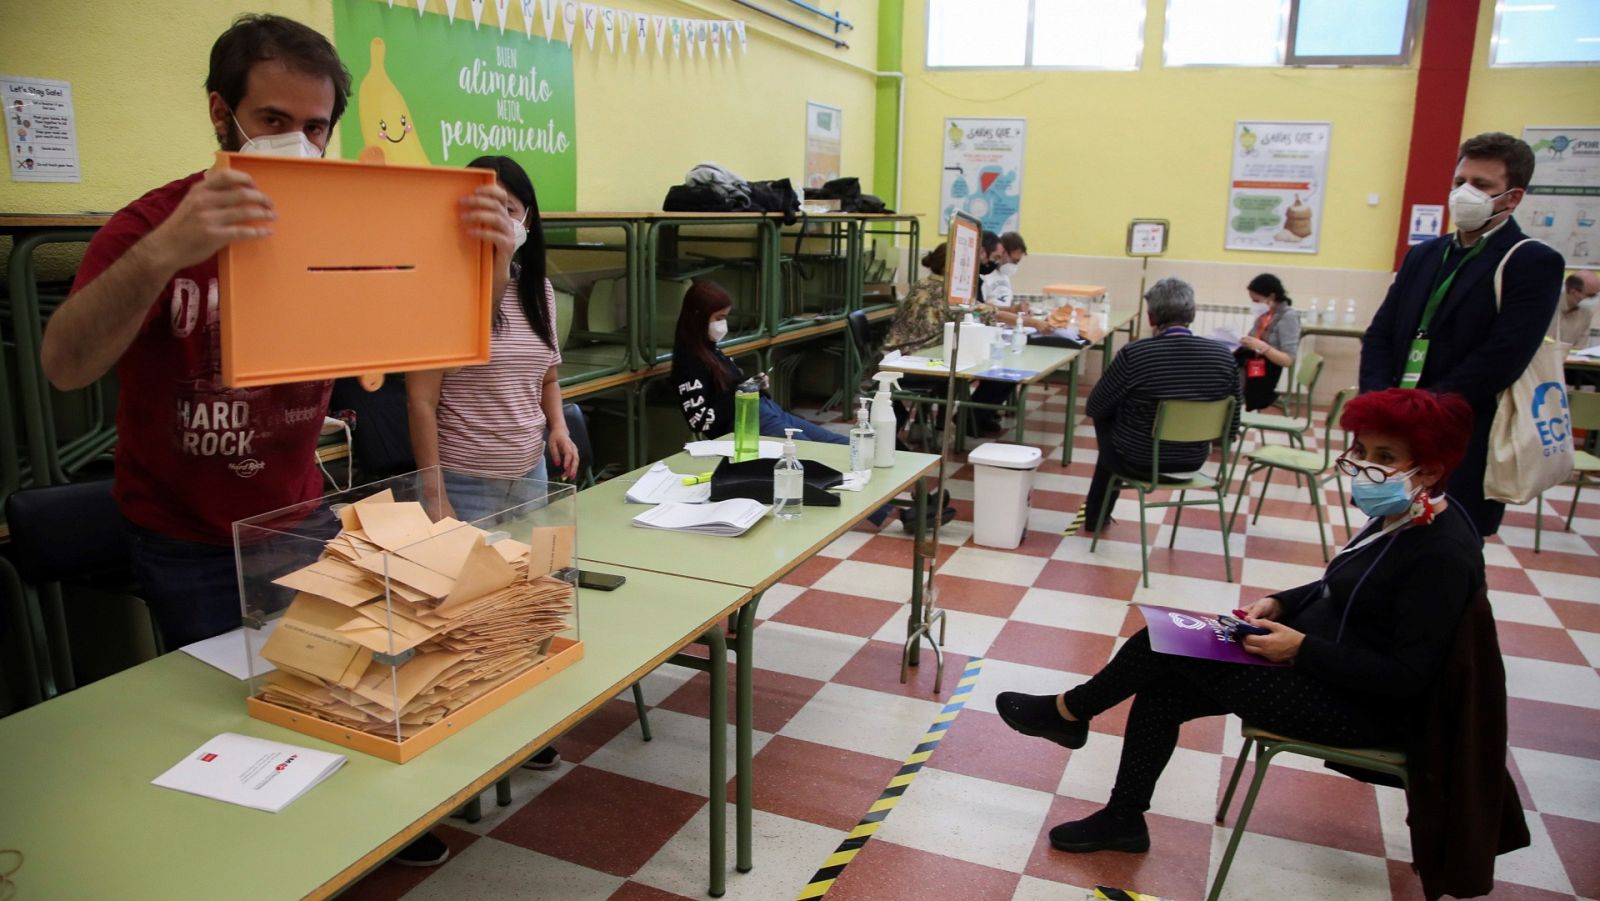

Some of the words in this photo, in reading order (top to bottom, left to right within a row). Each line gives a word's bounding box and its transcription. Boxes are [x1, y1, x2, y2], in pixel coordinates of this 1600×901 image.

[496, 45, 517, 68] BUEN
[9, 84, 26, 93] Let's
[28, 86, 44, 97] Stay
[45, 88, 63, 97] Safe!
[459, 58, 552, 102] alimento
[497, 99, 524, 124] MEJOR
[441, 119, 570, 161] pensamiento
[678, 379, 703, 395] FILA
[178, 400, 249, 430] HARD
[682, 394, 705, 412] FLA
[183, 430, 256, 457] ROCK
